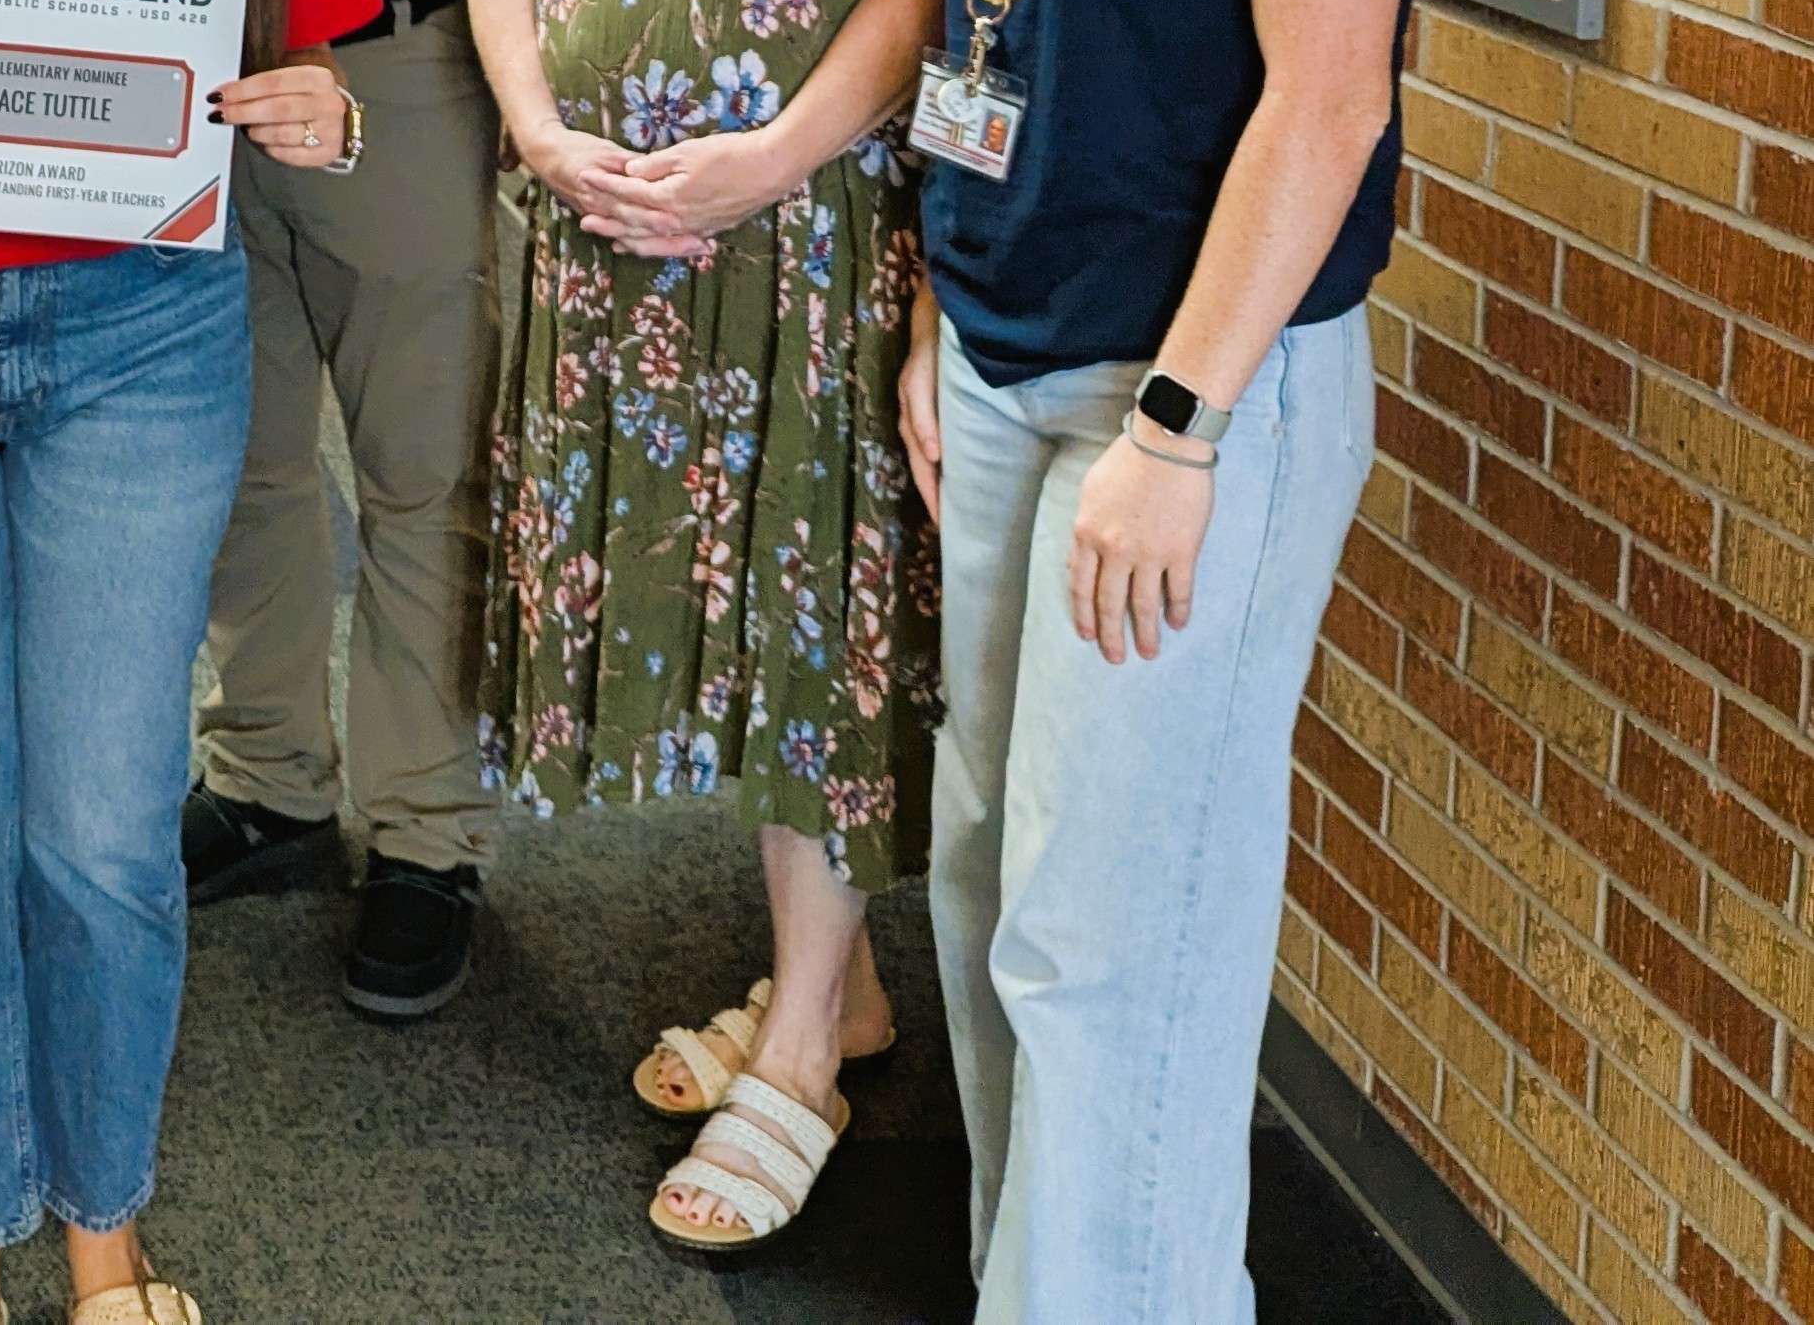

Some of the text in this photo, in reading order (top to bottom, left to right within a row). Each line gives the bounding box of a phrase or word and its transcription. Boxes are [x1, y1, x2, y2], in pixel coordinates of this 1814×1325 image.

[48, 0, 119, 16] SCHOOLS
[140, 8, 170, 21] USD
[178, 13, 208, 25] 428
[74, 68, 128, 86] NOMINEE
[43, 92, 113, 122] TUTTLE
[37, 163, 86, 181] AWARD
[46, 185, 108, 203] FIRST-YEAR
[111, 190, 166, 209] TEACHERS
